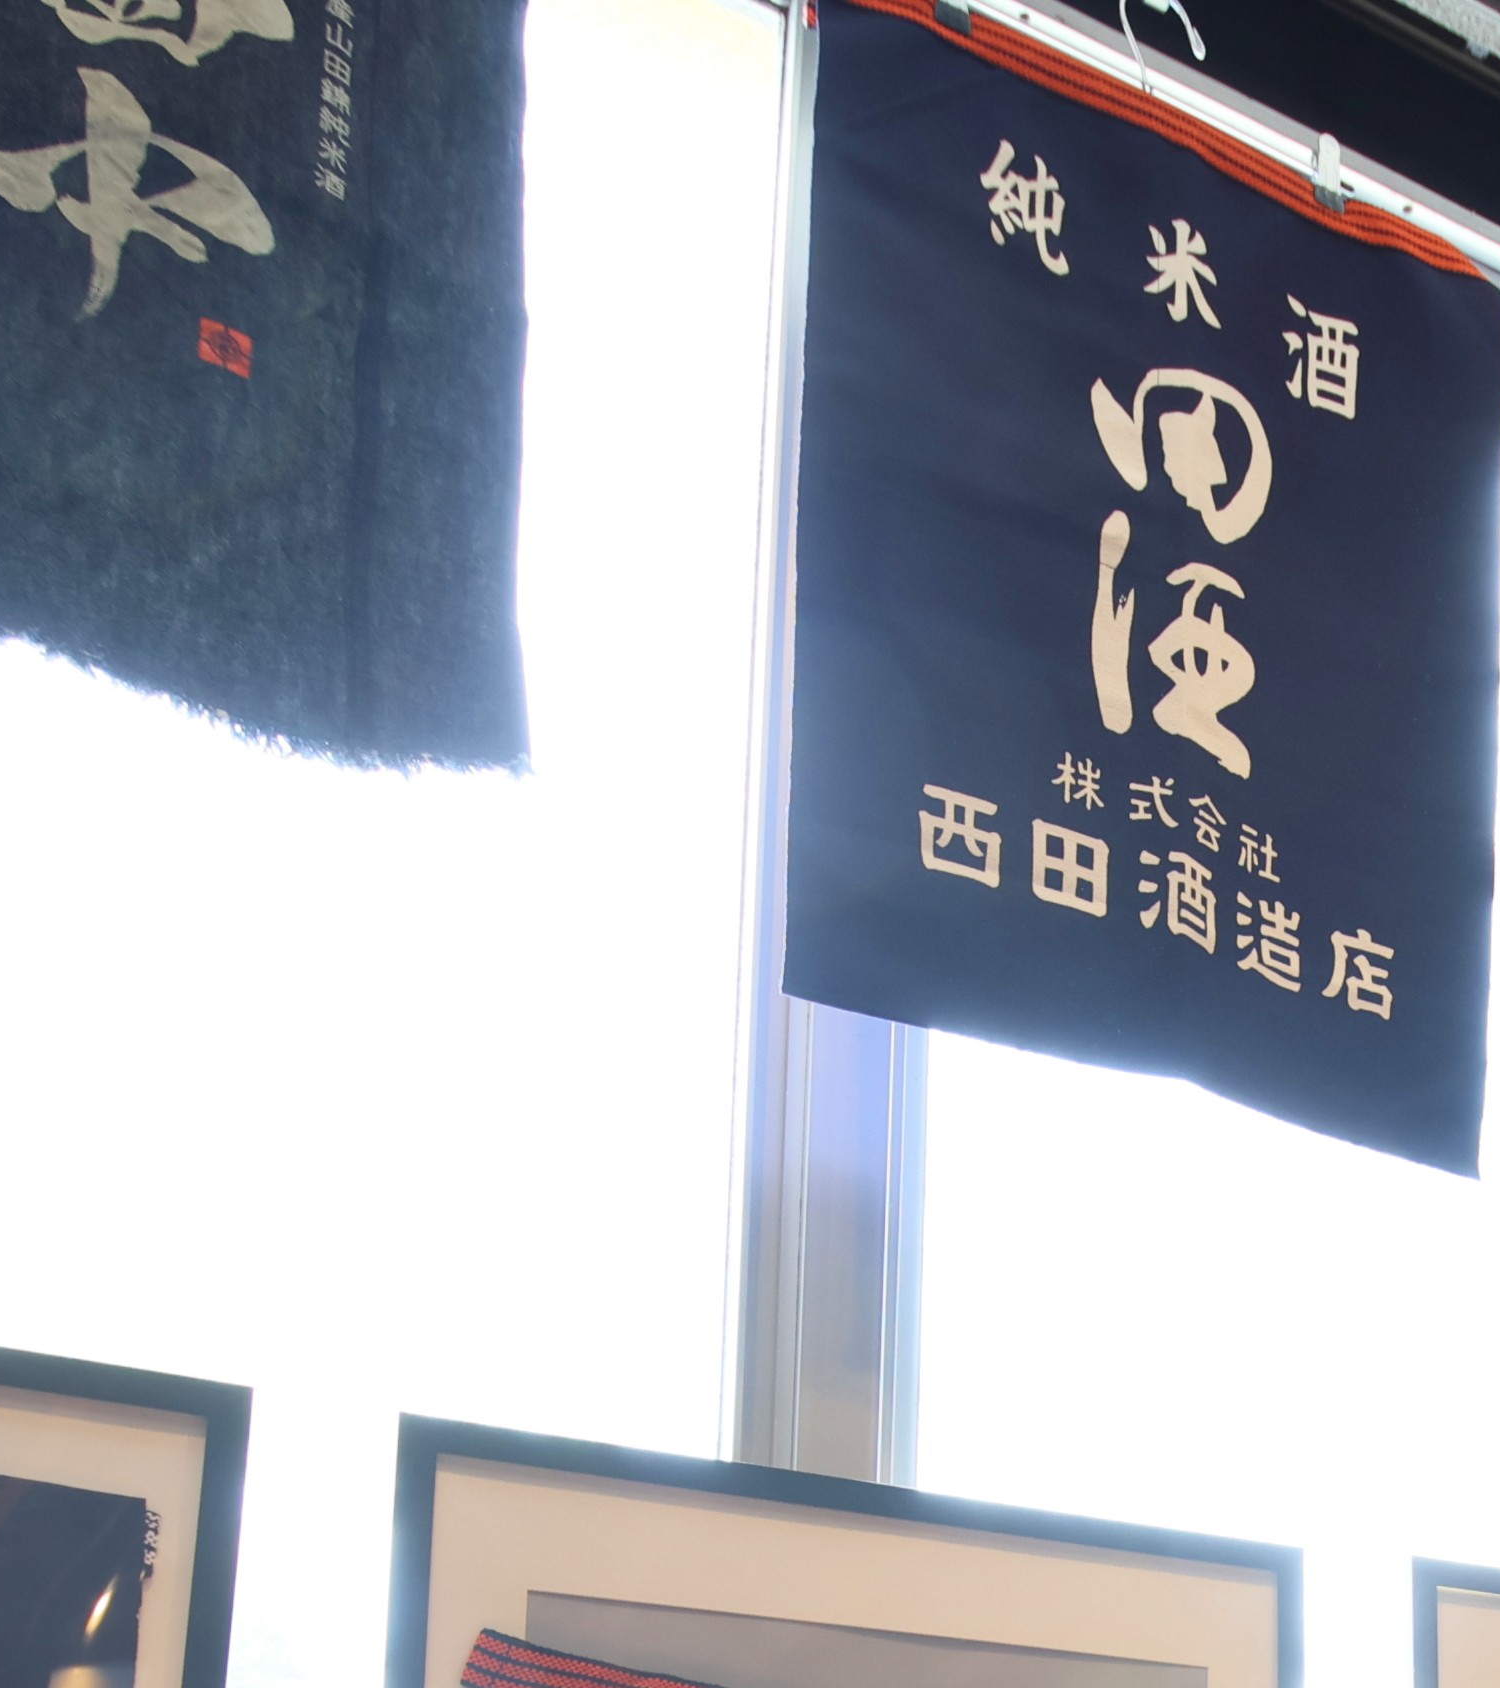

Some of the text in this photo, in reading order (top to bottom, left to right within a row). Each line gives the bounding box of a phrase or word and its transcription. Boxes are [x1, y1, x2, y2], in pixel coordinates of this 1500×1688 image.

[979, 139, 1360, 420] 純米酒
[1090, 366, 1273, 781] 田酒
[919, 783, 1396, 1021] 西田酒造店
[1052, 751, 1281, 885] 株式会社
